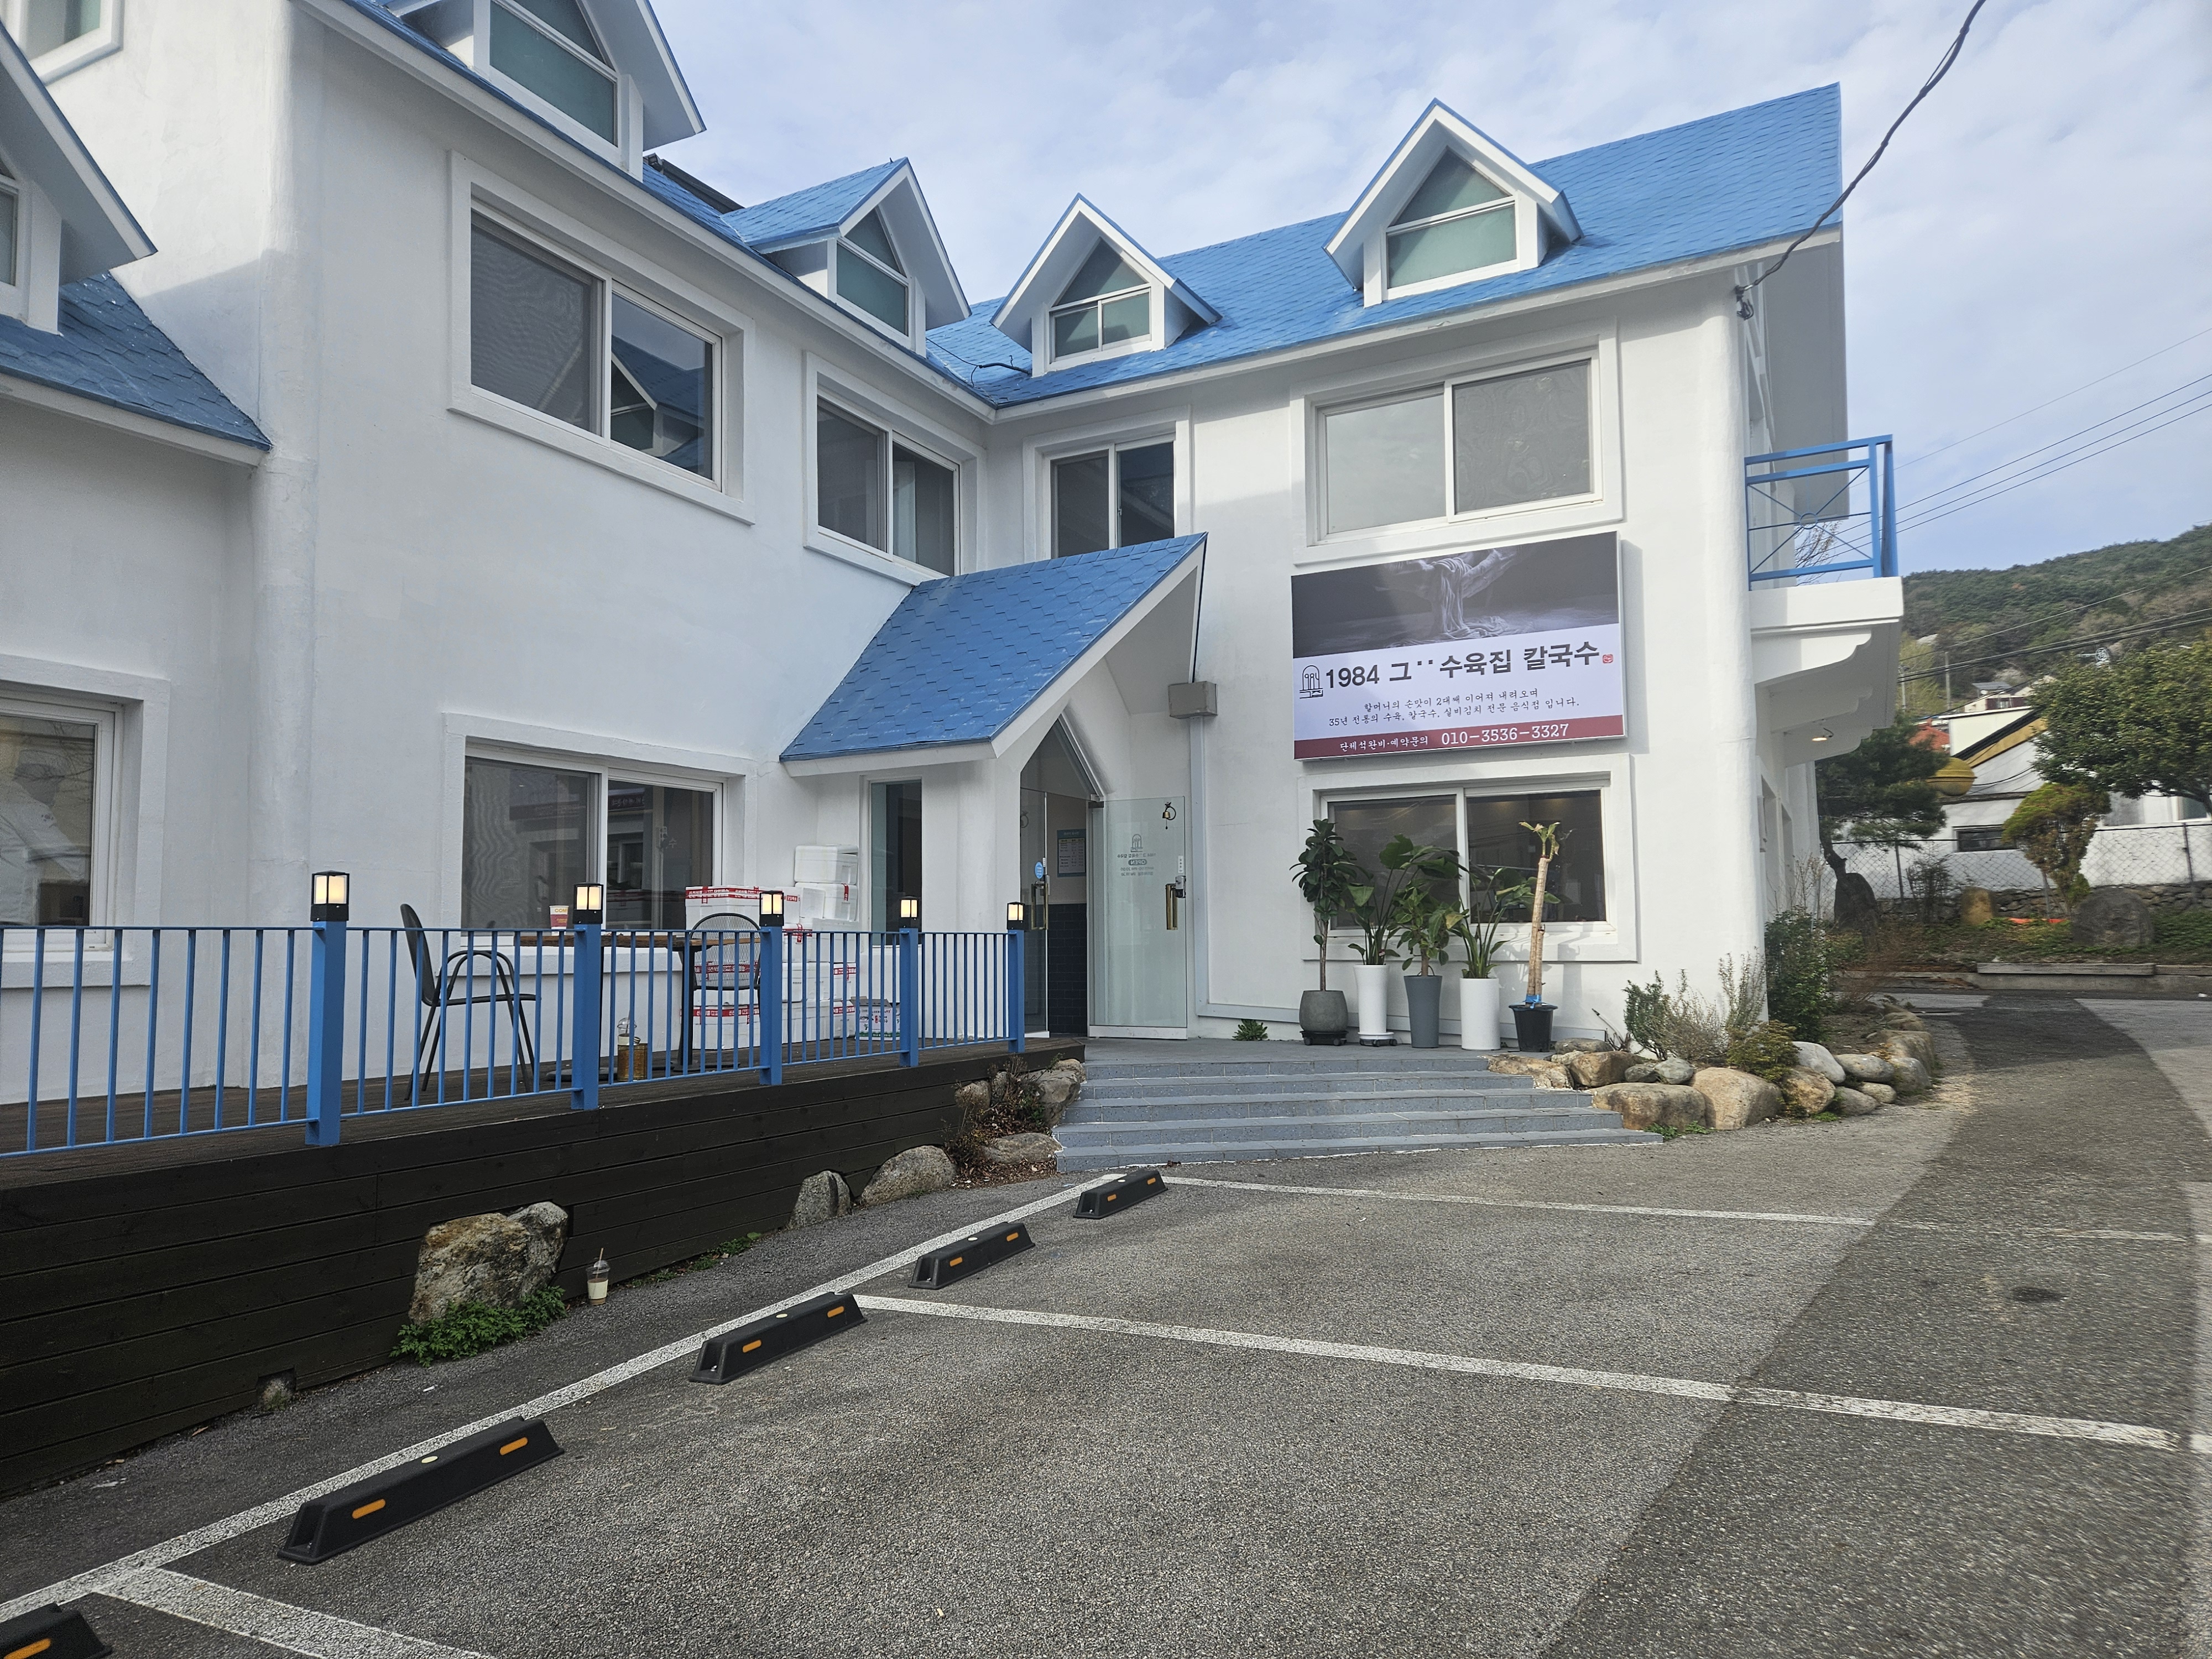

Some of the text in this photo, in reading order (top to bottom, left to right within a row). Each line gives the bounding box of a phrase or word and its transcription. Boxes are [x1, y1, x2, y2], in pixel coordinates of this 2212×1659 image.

[1326, 664, 1380, 688] 1984
[1524, 641, 1600, 671] 칼국수
[1329, 716, 1348, 727] 35년
[1352, 714, 1379, 725] 전통의
[1444, 705, 1481, 717] 실비김치
[1486, 702, 1507, 713] 전문
[1510, 700, 1540, 712] 음식점
[1545, 697, 1580, 709] 입니다.
[1364, 700, 1400, 713] 할머니의
[1405, 698, 1432, 709] 손맛이
[1465, 692, 1494, 703] 이어져
[1498, 688, 1538, 700] 내려오며
[1441, 723, 1569, 745] 010-3536-3327
